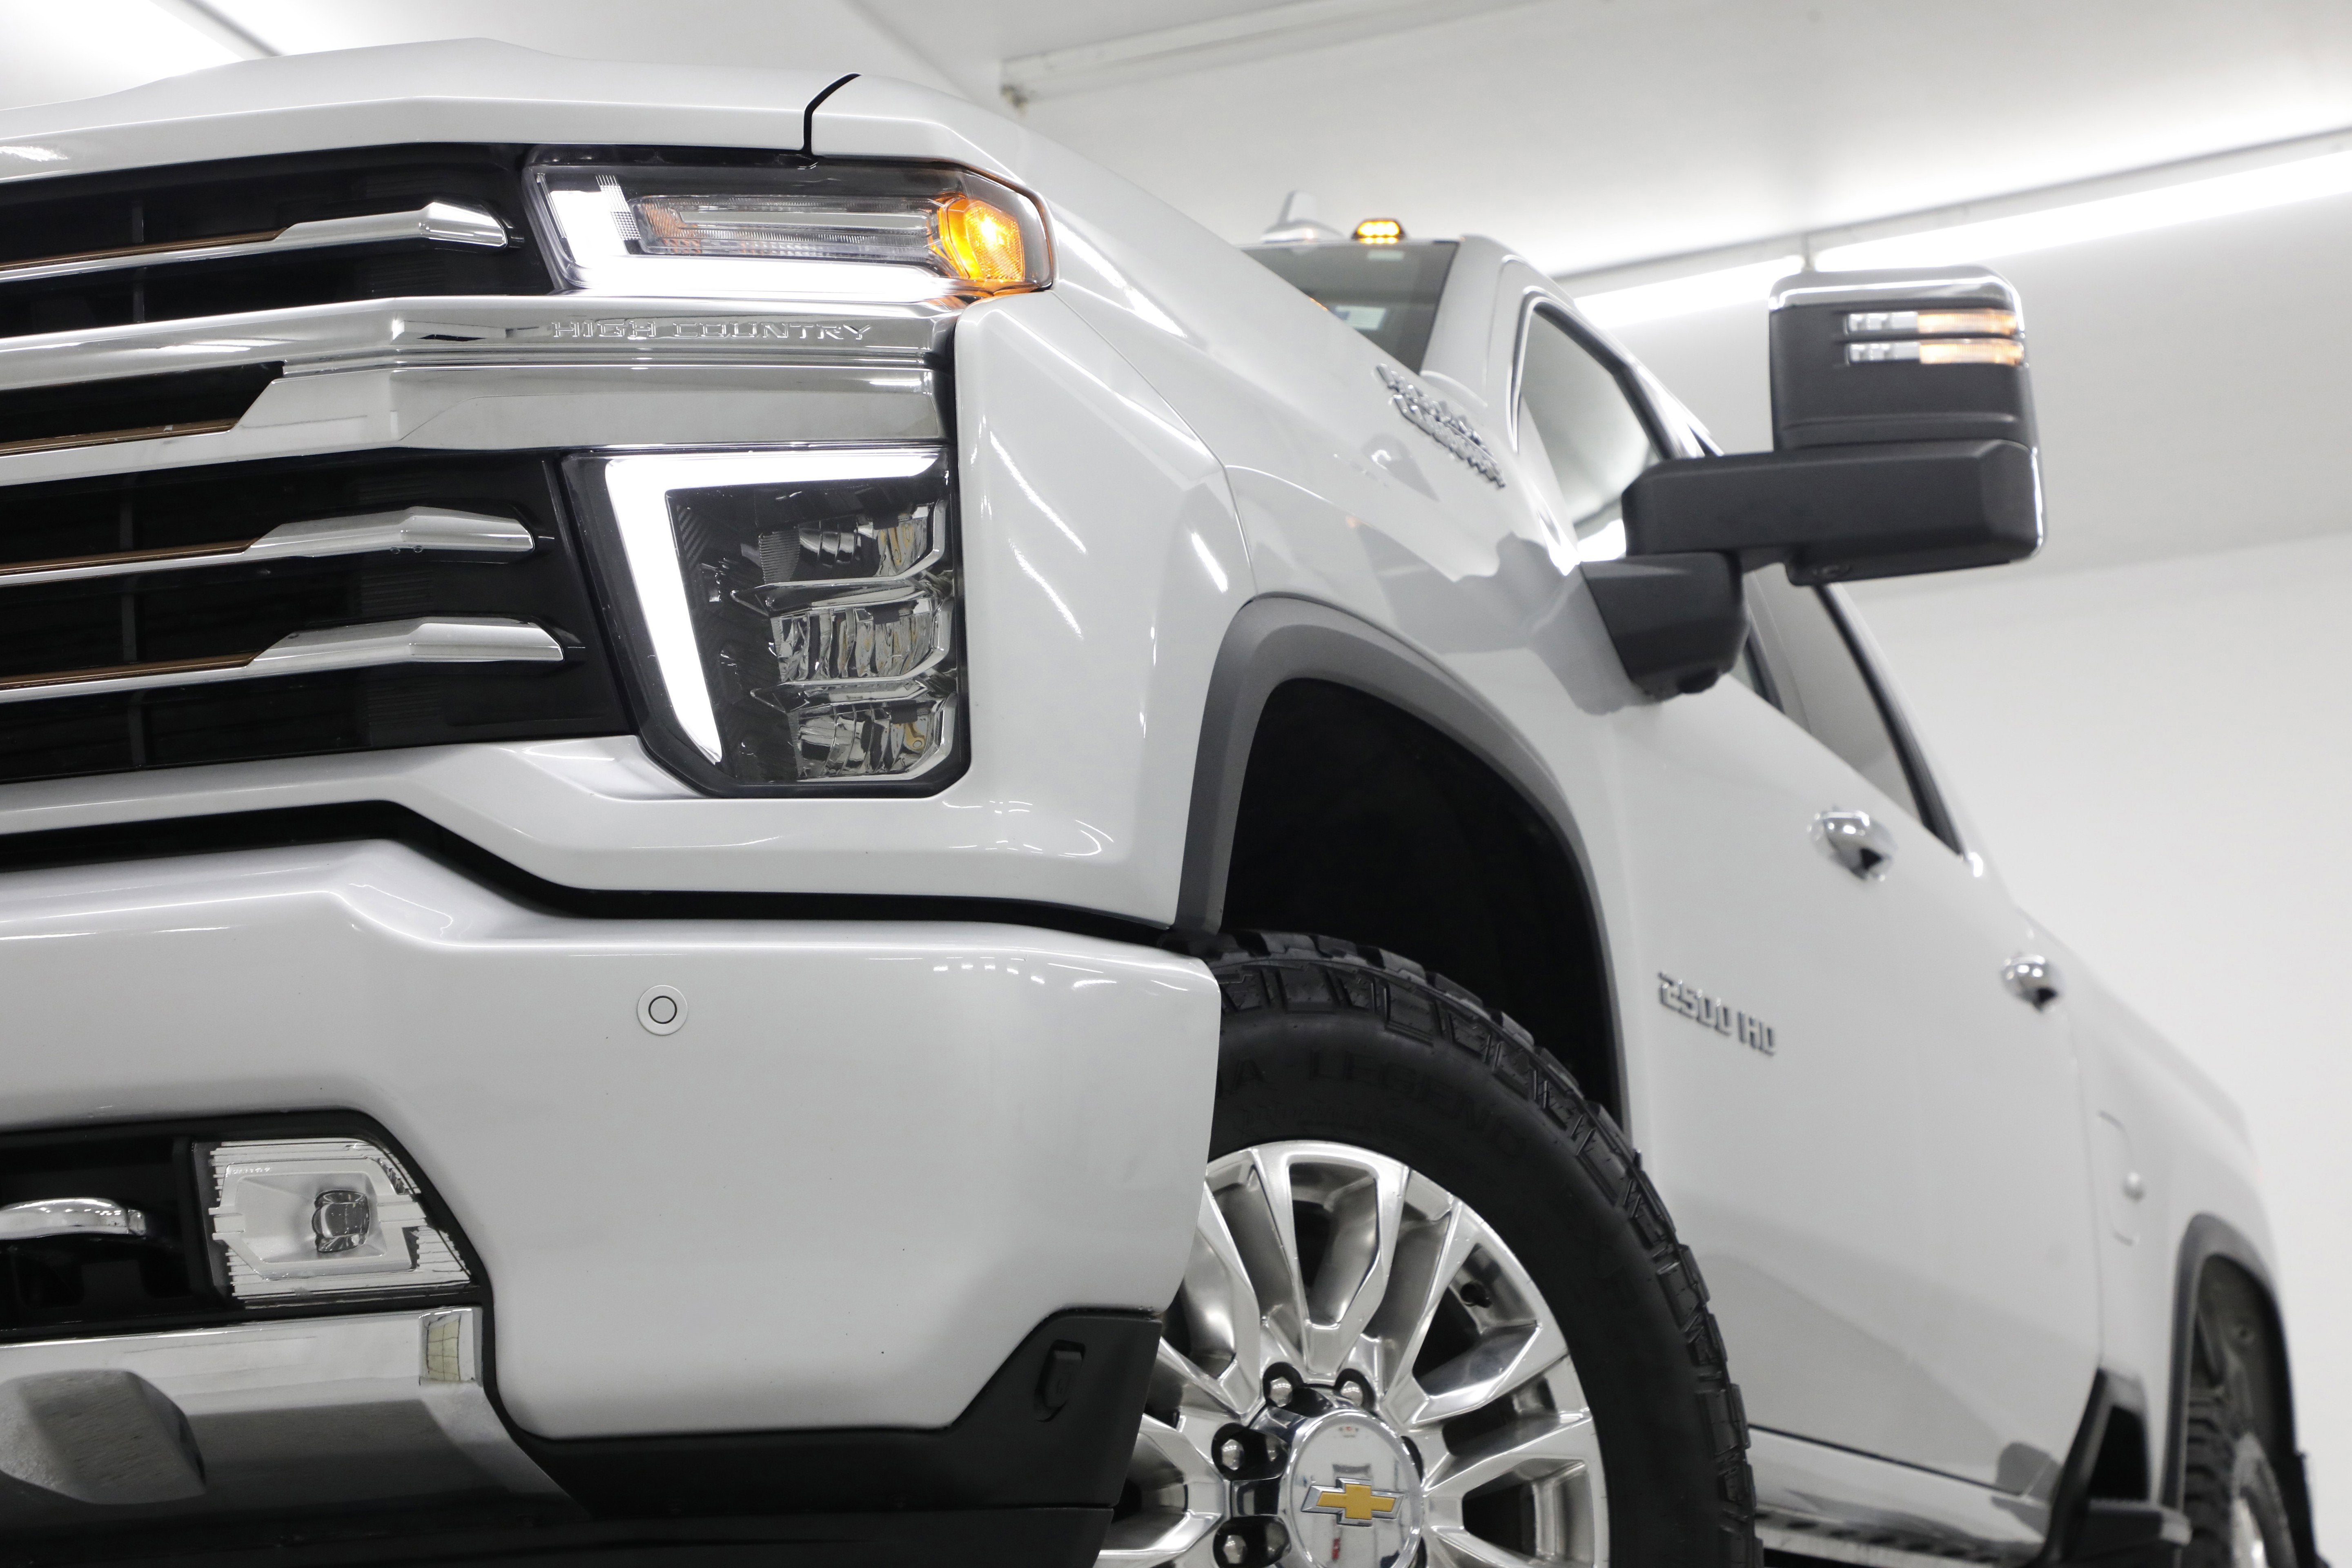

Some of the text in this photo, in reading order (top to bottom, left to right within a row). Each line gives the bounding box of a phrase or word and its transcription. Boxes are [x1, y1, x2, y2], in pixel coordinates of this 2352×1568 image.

[552, 320, 871, 339] HIGH COUNTRY
[1658, 971, 1776, 1057] 2500 HD
